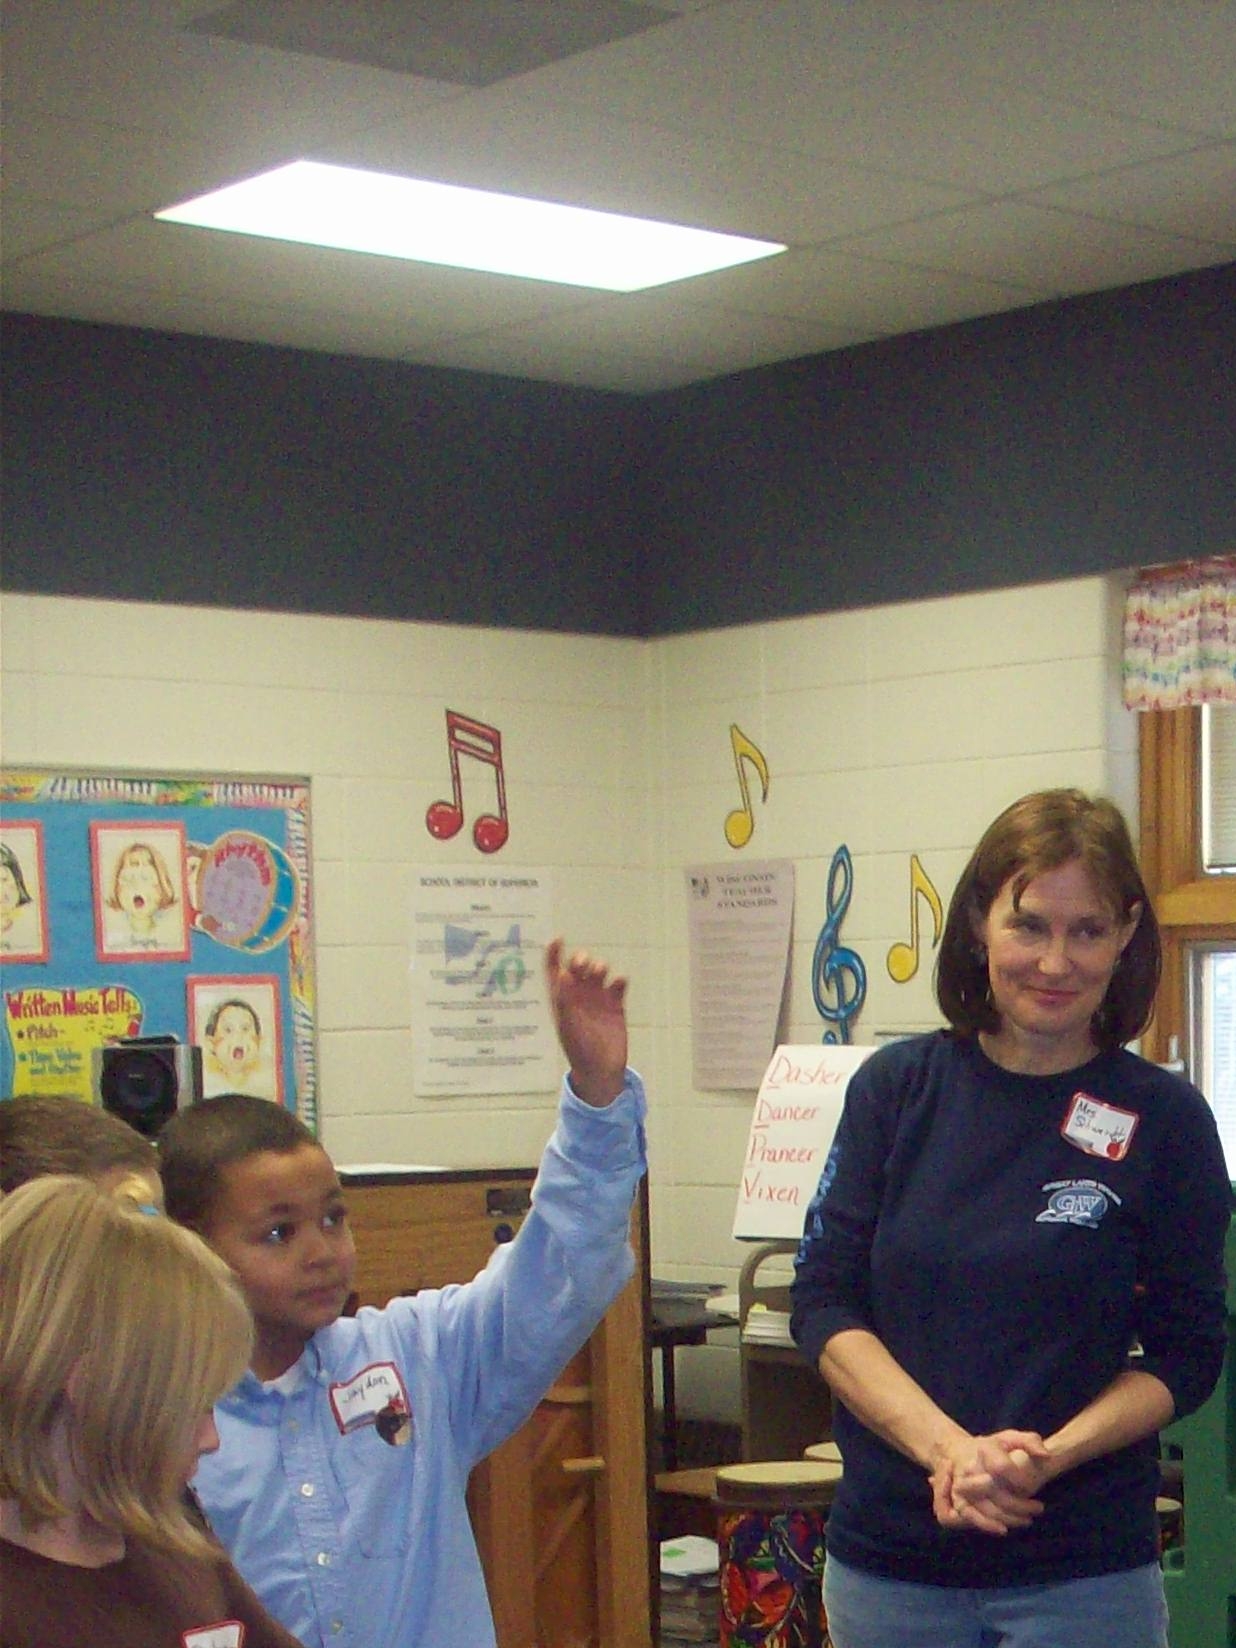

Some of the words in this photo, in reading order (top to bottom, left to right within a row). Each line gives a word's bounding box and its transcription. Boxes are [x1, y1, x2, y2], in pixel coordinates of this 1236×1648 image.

[6, 991, 61, 1019] Written
[62, 988, 99, 1017] Music
[768, 1055, 844, 1085] Dasher
[757, 1099, 821, 1122] Dancer
[750, 1134, 818, 1163] Prancer
[743, 1172, 801, 1205] Vixen
